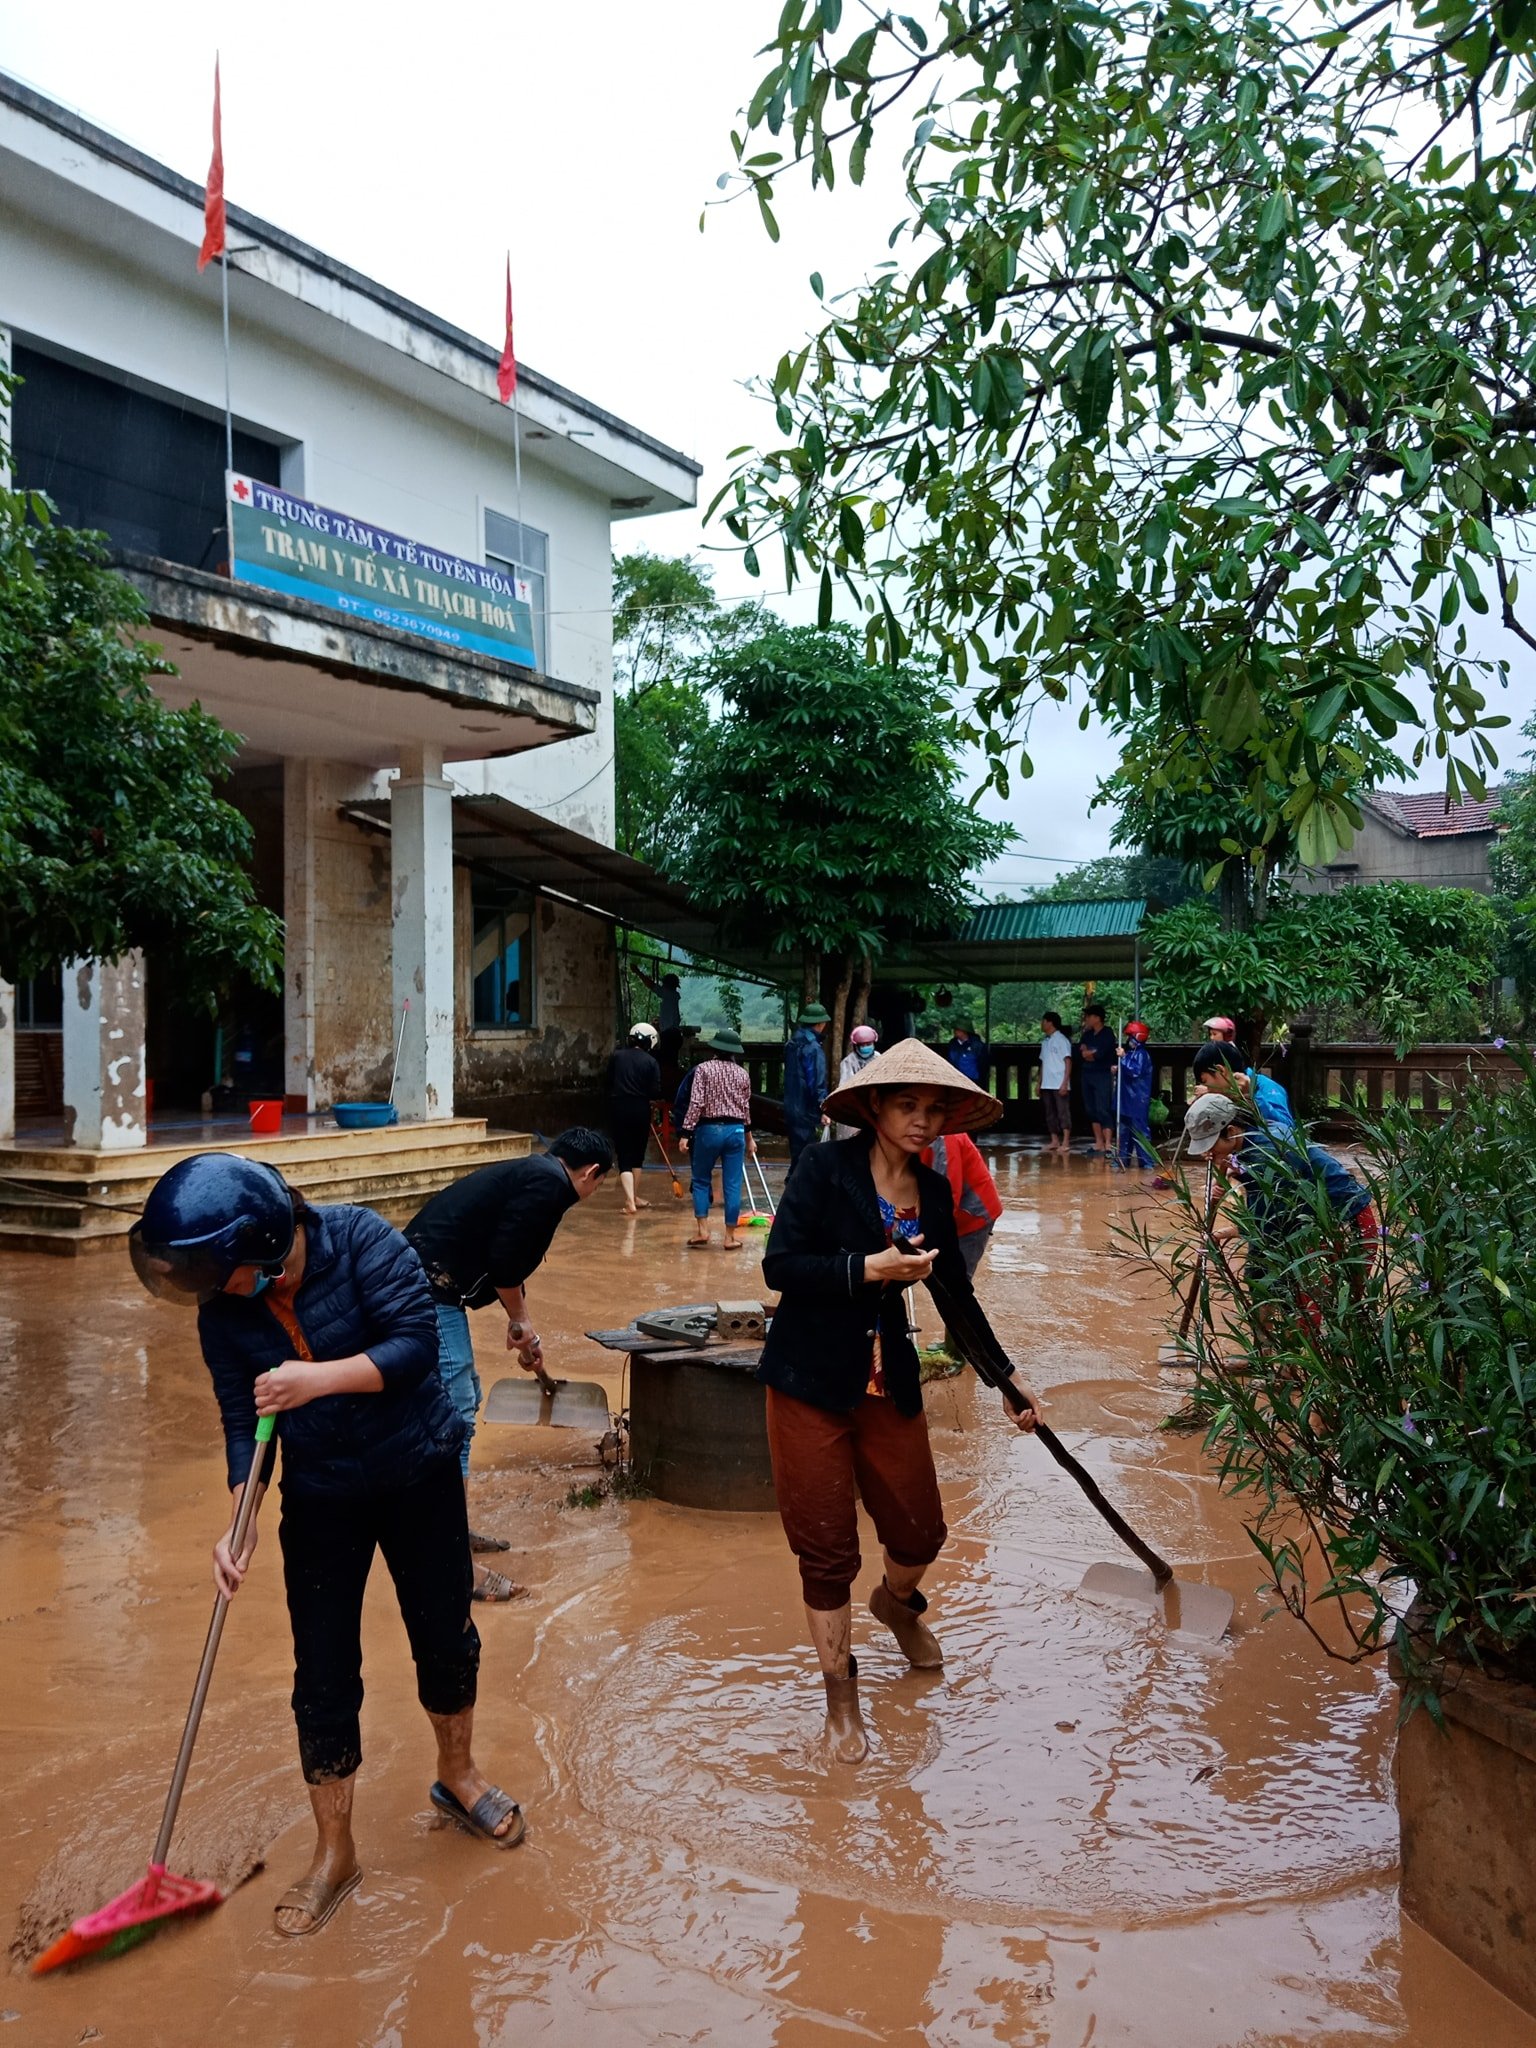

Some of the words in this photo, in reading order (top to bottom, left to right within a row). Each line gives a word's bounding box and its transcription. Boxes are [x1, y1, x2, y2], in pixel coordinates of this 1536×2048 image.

[256, 490, 330, 533] TRUNG
[333, 519, 374, 549] TÂM
[377, 535, 390, 555] Y
[393, 541, 418, 564] TẾ
[420, 551, 477, 585] TUYÊN
[480, 571, 514, 597] HÓA
[261, 525, 328, 572] TRẠM
[331, 549, 346, 577] Y
[351, 551, 378, 588] TẾ
[381, 566, 411, 599] XÃ
[414, 577, 477, 620] THẠCH
[480, 601, 517, 633] HOÁ
